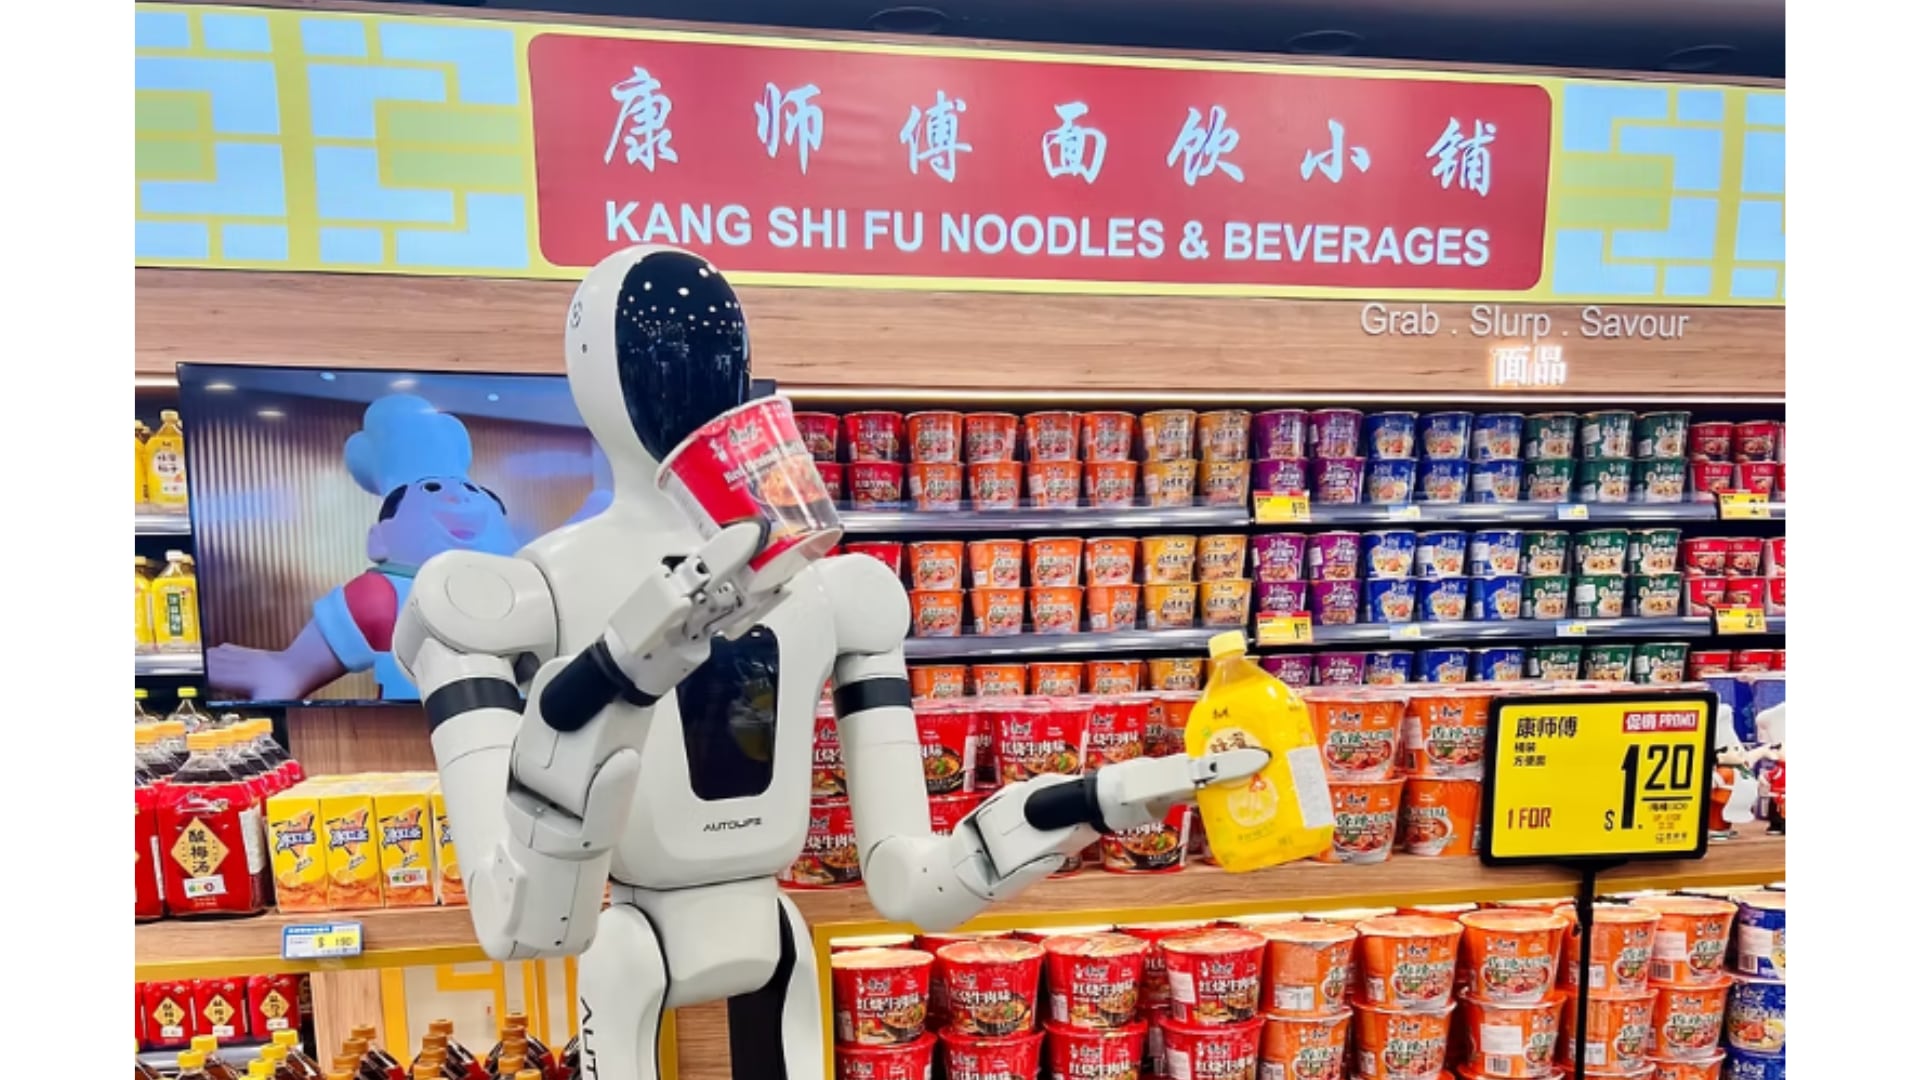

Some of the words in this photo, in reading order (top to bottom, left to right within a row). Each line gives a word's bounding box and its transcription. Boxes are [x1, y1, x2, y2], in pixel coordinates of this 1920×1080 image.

[604, 66, 1497, 197] 康师傅面饮小铺
[605, 200, 752, 246] KANG
[768, 206, 846, 250] SHI
[864, 210, 923, 252] FU
[941, 213, 1164, 258] NOODLES
[1179, 220, 1209, 260] &
[1224, 222, 1490, 266] BEVERAGES
[1361, 303, 1439, 336] Grab
[1470, 304, 1552, 343] Slurp
[1580, 306, 1689, 338] Savour
[1492, 345, 1567, 387] 面品
[1515, 716, 1578, 738] 康师傅
[1659, 712, 1697, 728] PROMO
[1507, 808, 1514, 830] 1
[1519, 807, 1552, 829] FOR
[188, 829, 211, 873] 酸梅汤
